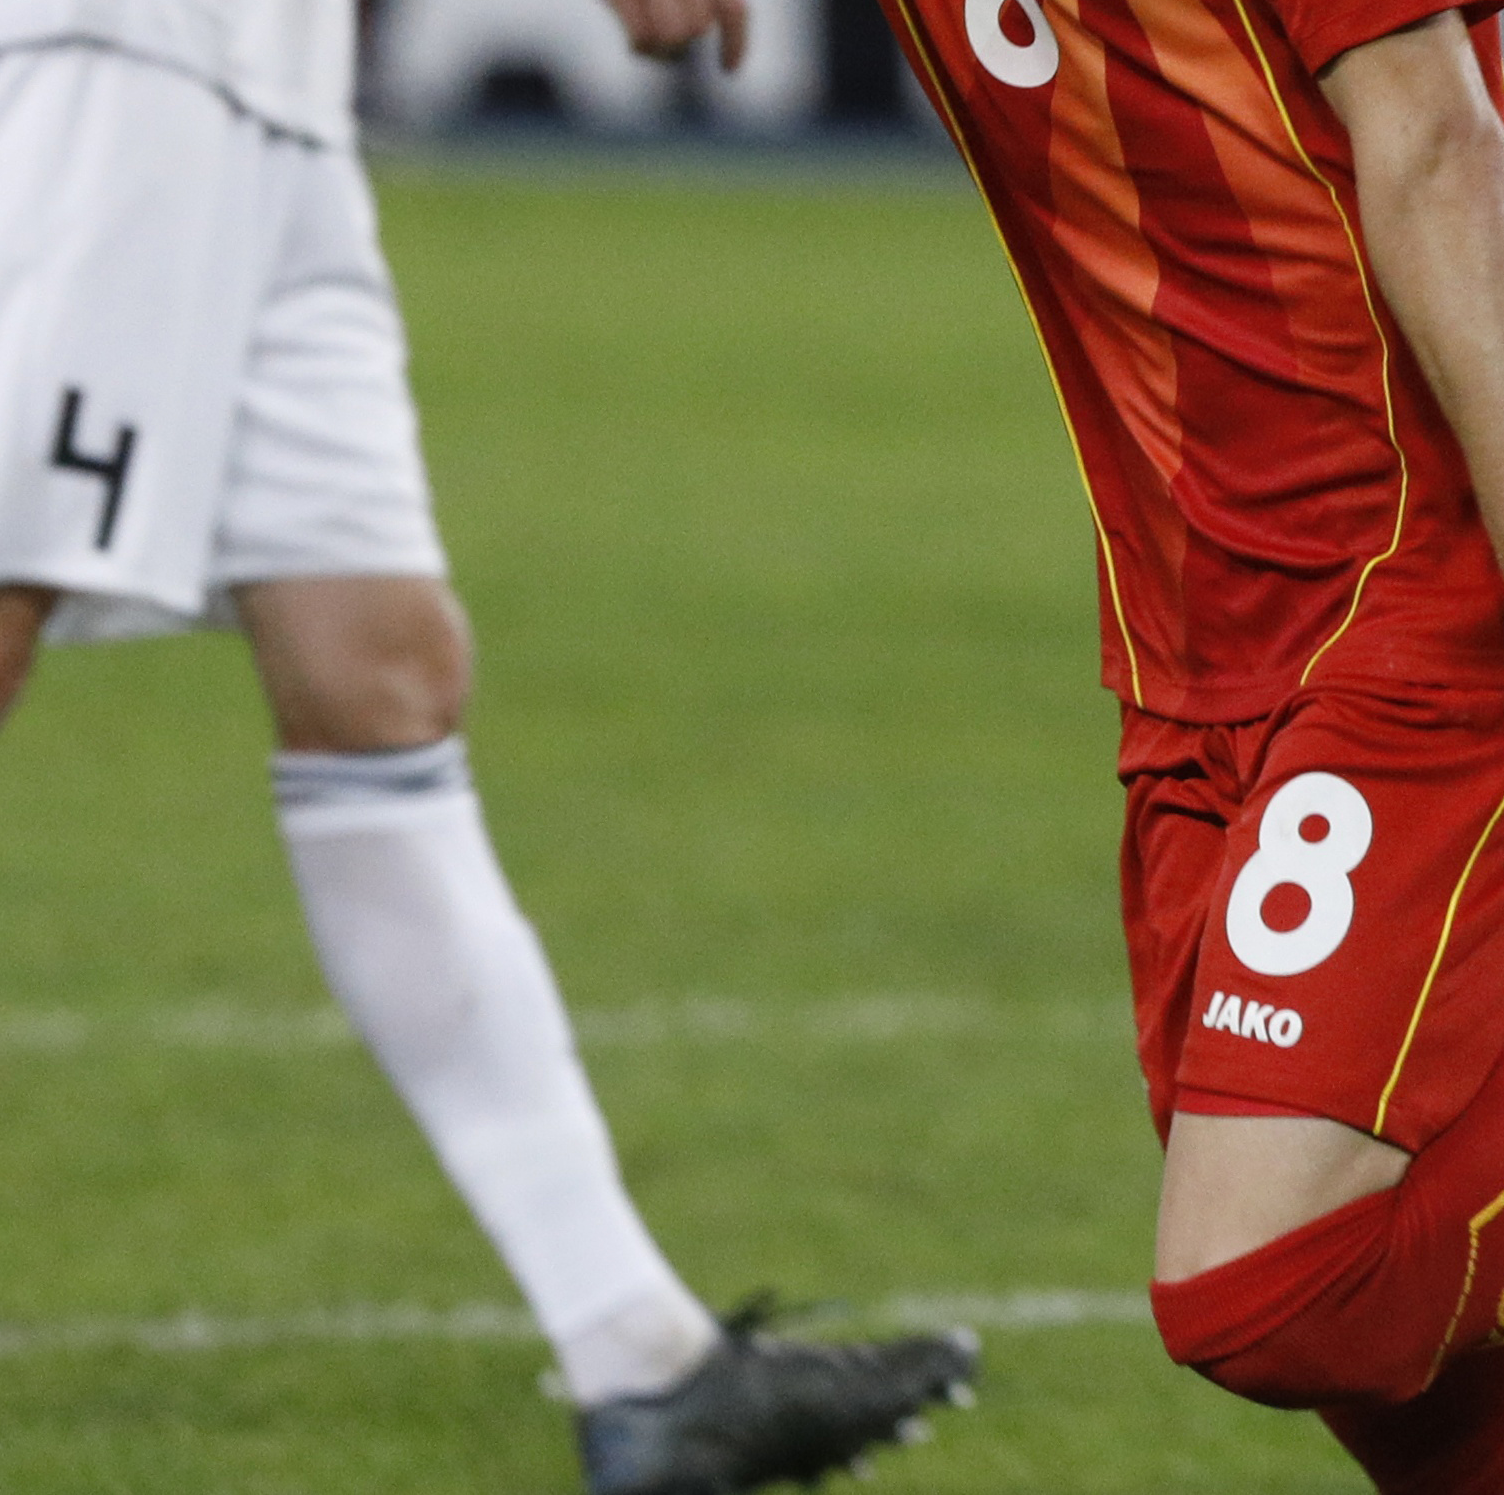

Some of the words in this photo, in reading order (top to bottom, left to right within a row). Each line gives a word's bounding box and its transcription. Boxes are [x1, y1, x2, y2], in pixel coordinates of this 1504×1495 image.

[50, 383, 138, 551] 4
[1226, 771, 1373, 976] 8
[1202, 990, 1304, 1048] JAKO
